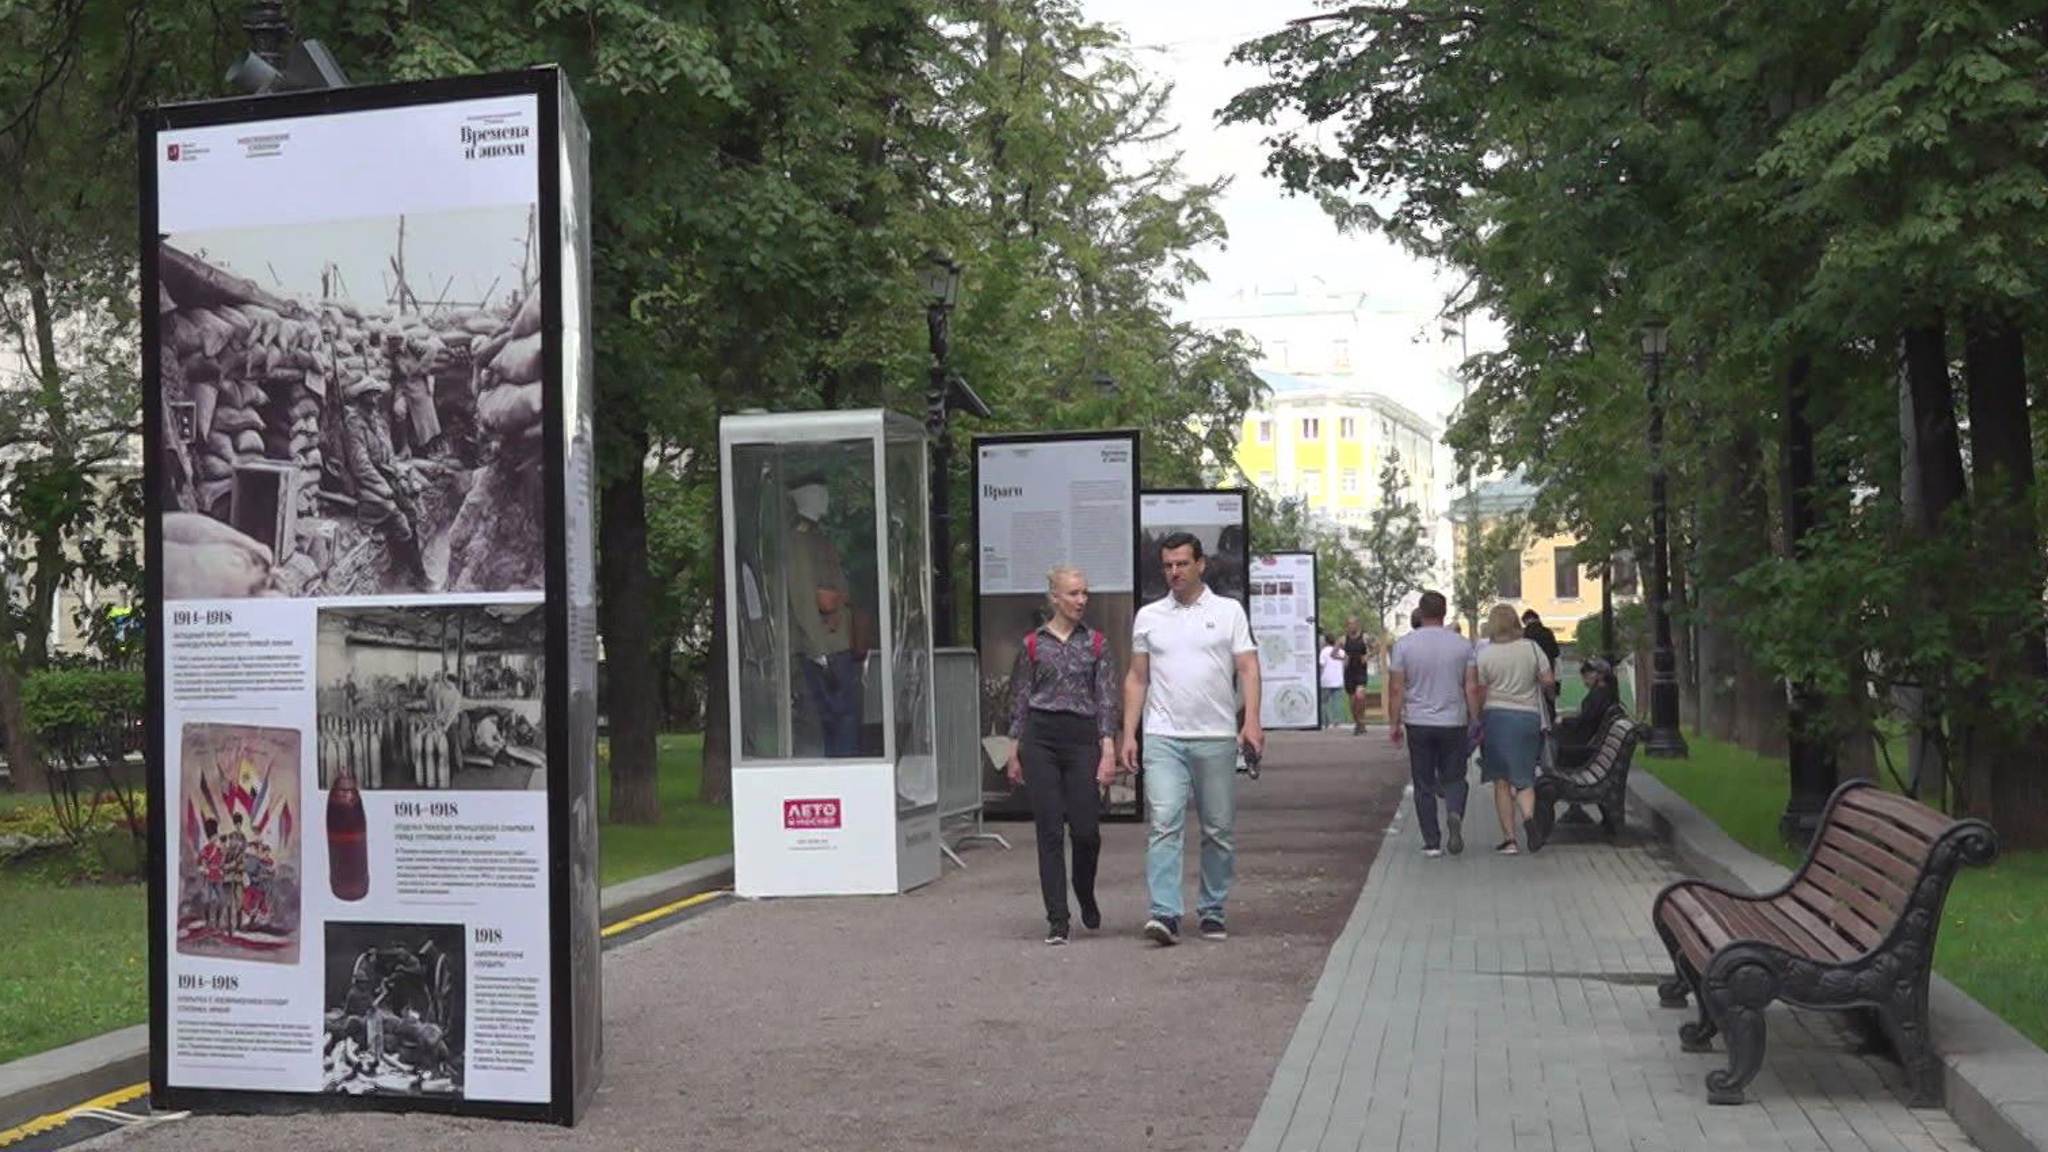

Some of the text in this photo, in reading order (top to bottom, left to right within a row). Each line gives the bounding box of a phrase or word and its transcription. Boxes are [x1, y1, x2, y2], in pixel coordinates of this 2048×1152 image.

[461, 126, 530, 146] Времена
[465, 144, 526, 159] и эпохи
[983, 485, 1022, 502] Враги
[787, 803, 837, 817] ЛЕТО
[474, 928, 503, 944] 1918
